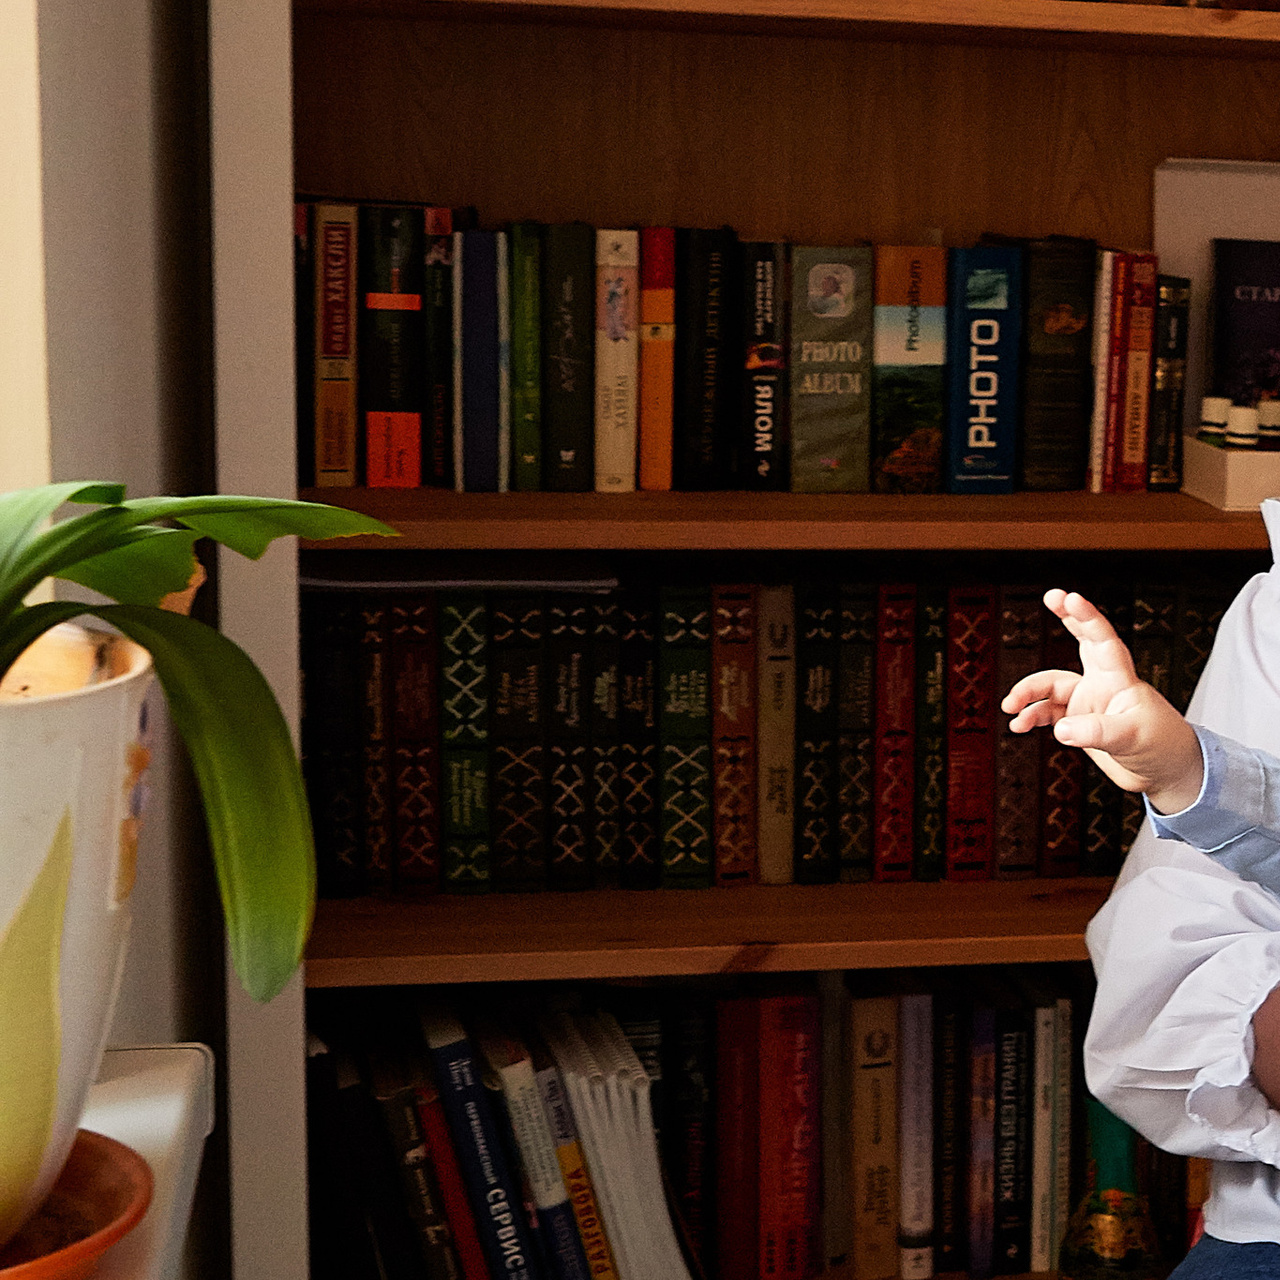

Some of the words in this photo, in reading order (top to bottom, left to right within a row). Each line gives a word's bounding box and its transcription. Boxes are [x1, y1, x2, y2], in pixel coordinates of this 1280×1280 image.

[326, 229, 348, 303] ХАКСЛИ
[906, 259, 923, 353] Photoalbum
[799, 372, 863, 395] ALBUM
[800, 341, 863, 364] PHOTO
[967, 317, 1001, 450] PHOTO
[753, 384, 775, 453] ЯЛОМ
[1002, 1031, 1019, 1100] ГРАНИЦ
[1001, 1101, 1018, 1138] БЕЗ
[1000, 1140, 1017, 1202] ЖИЗНЬ
[485, 1186, 526, 1271] СЕРВИС
[568, 1167, 609, 1277] РАЗГОВОРА
